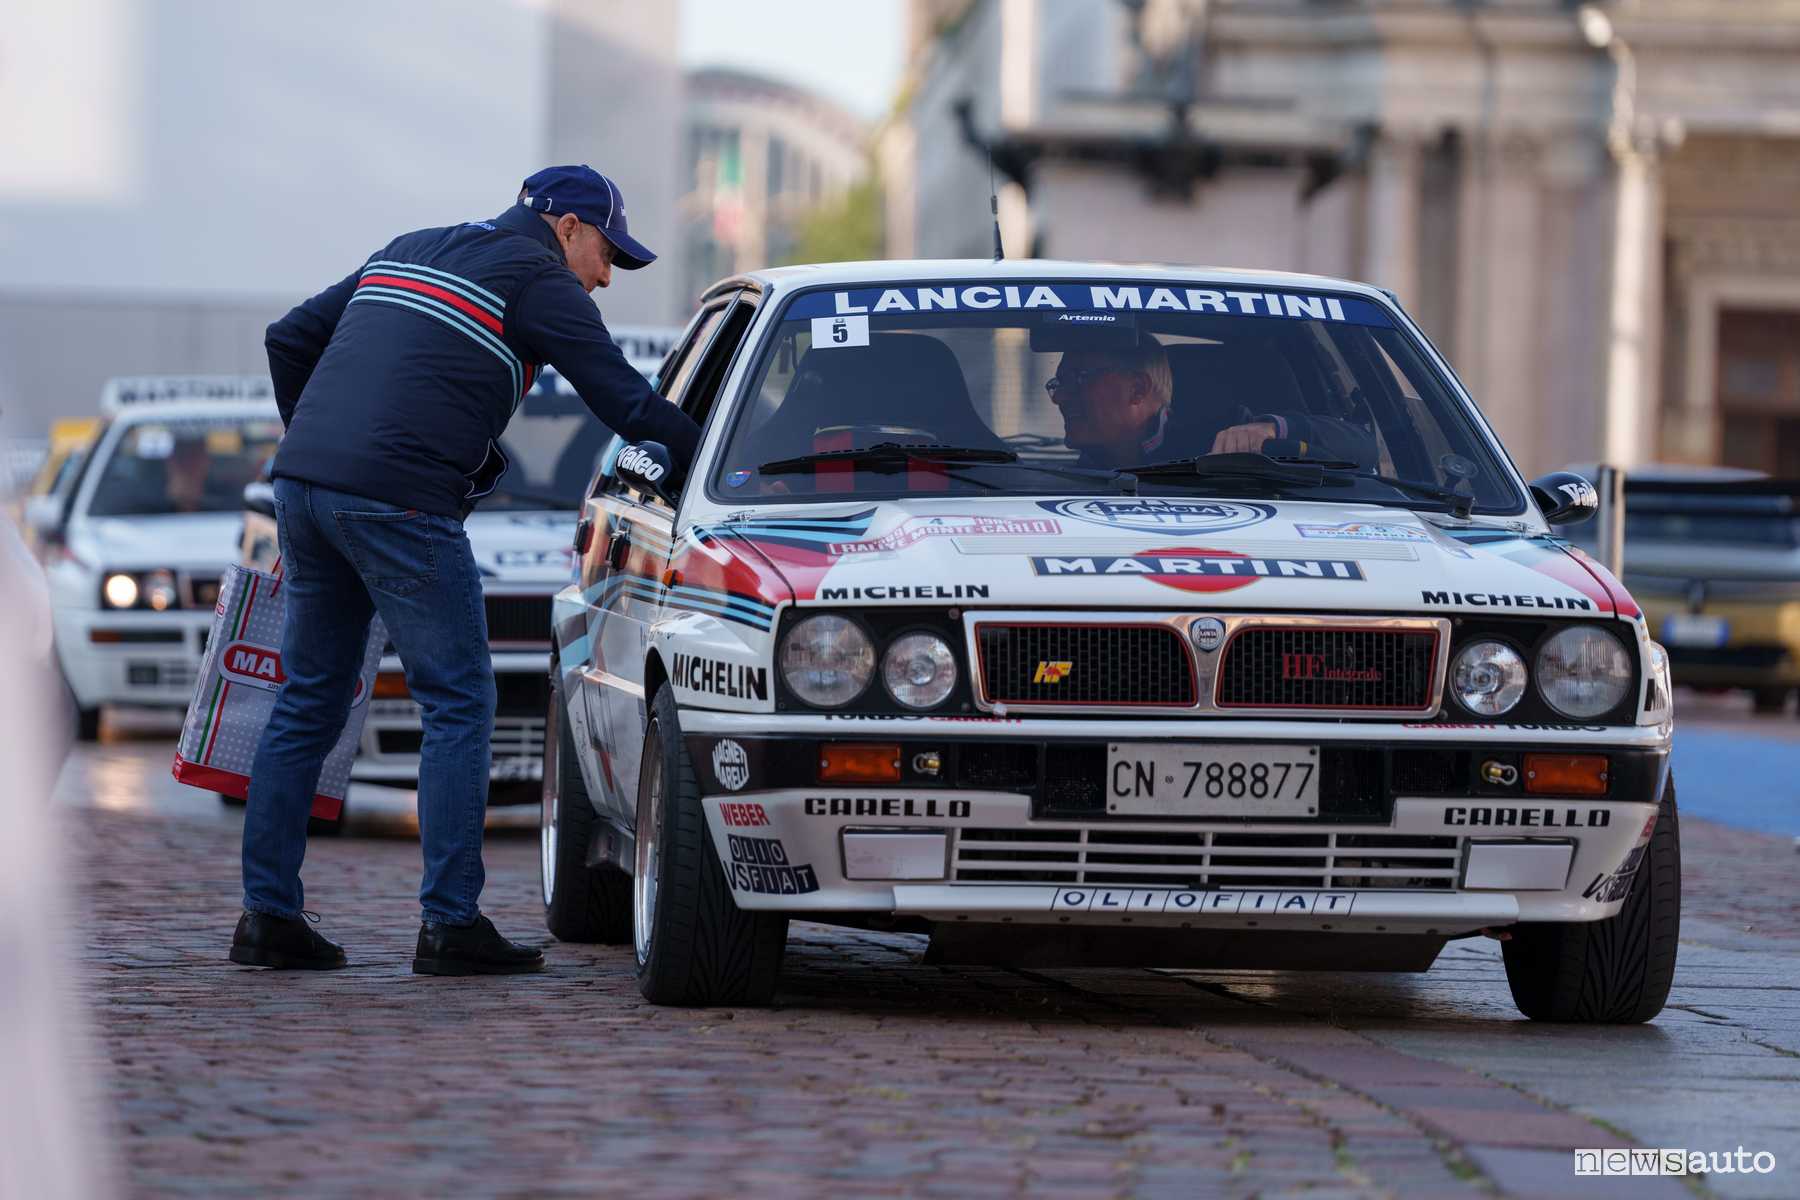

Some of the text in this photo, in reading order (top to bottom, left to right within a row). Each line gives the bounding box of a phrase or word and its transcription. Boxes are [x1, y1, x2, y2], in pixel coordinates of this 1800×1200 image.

[834, 286, 1346, 321] LANCIA MARTINI
[1058, 314, 1116, 322] Artemio
[832, 323, 849, 344] 5
[617, 445, 665, 481] Valeo
[1043, 556, 1353, 580] MARTINI
[821, 584, 990, 600] MICHELIN
[1421, 590, 1592, 611] MICHELIN
[671, 652, 768, 701] MICHELIN
[1281, 653, 1326, 680] HF
[1112, 760, 1315, 799] CN 788877
[719, 802, 771, 827] WEBER
[804, 797, 972, 818] CARELLO
[1443, 807, 1611, 827] CARELLO
[730, 837, 785, 863] OLIO
